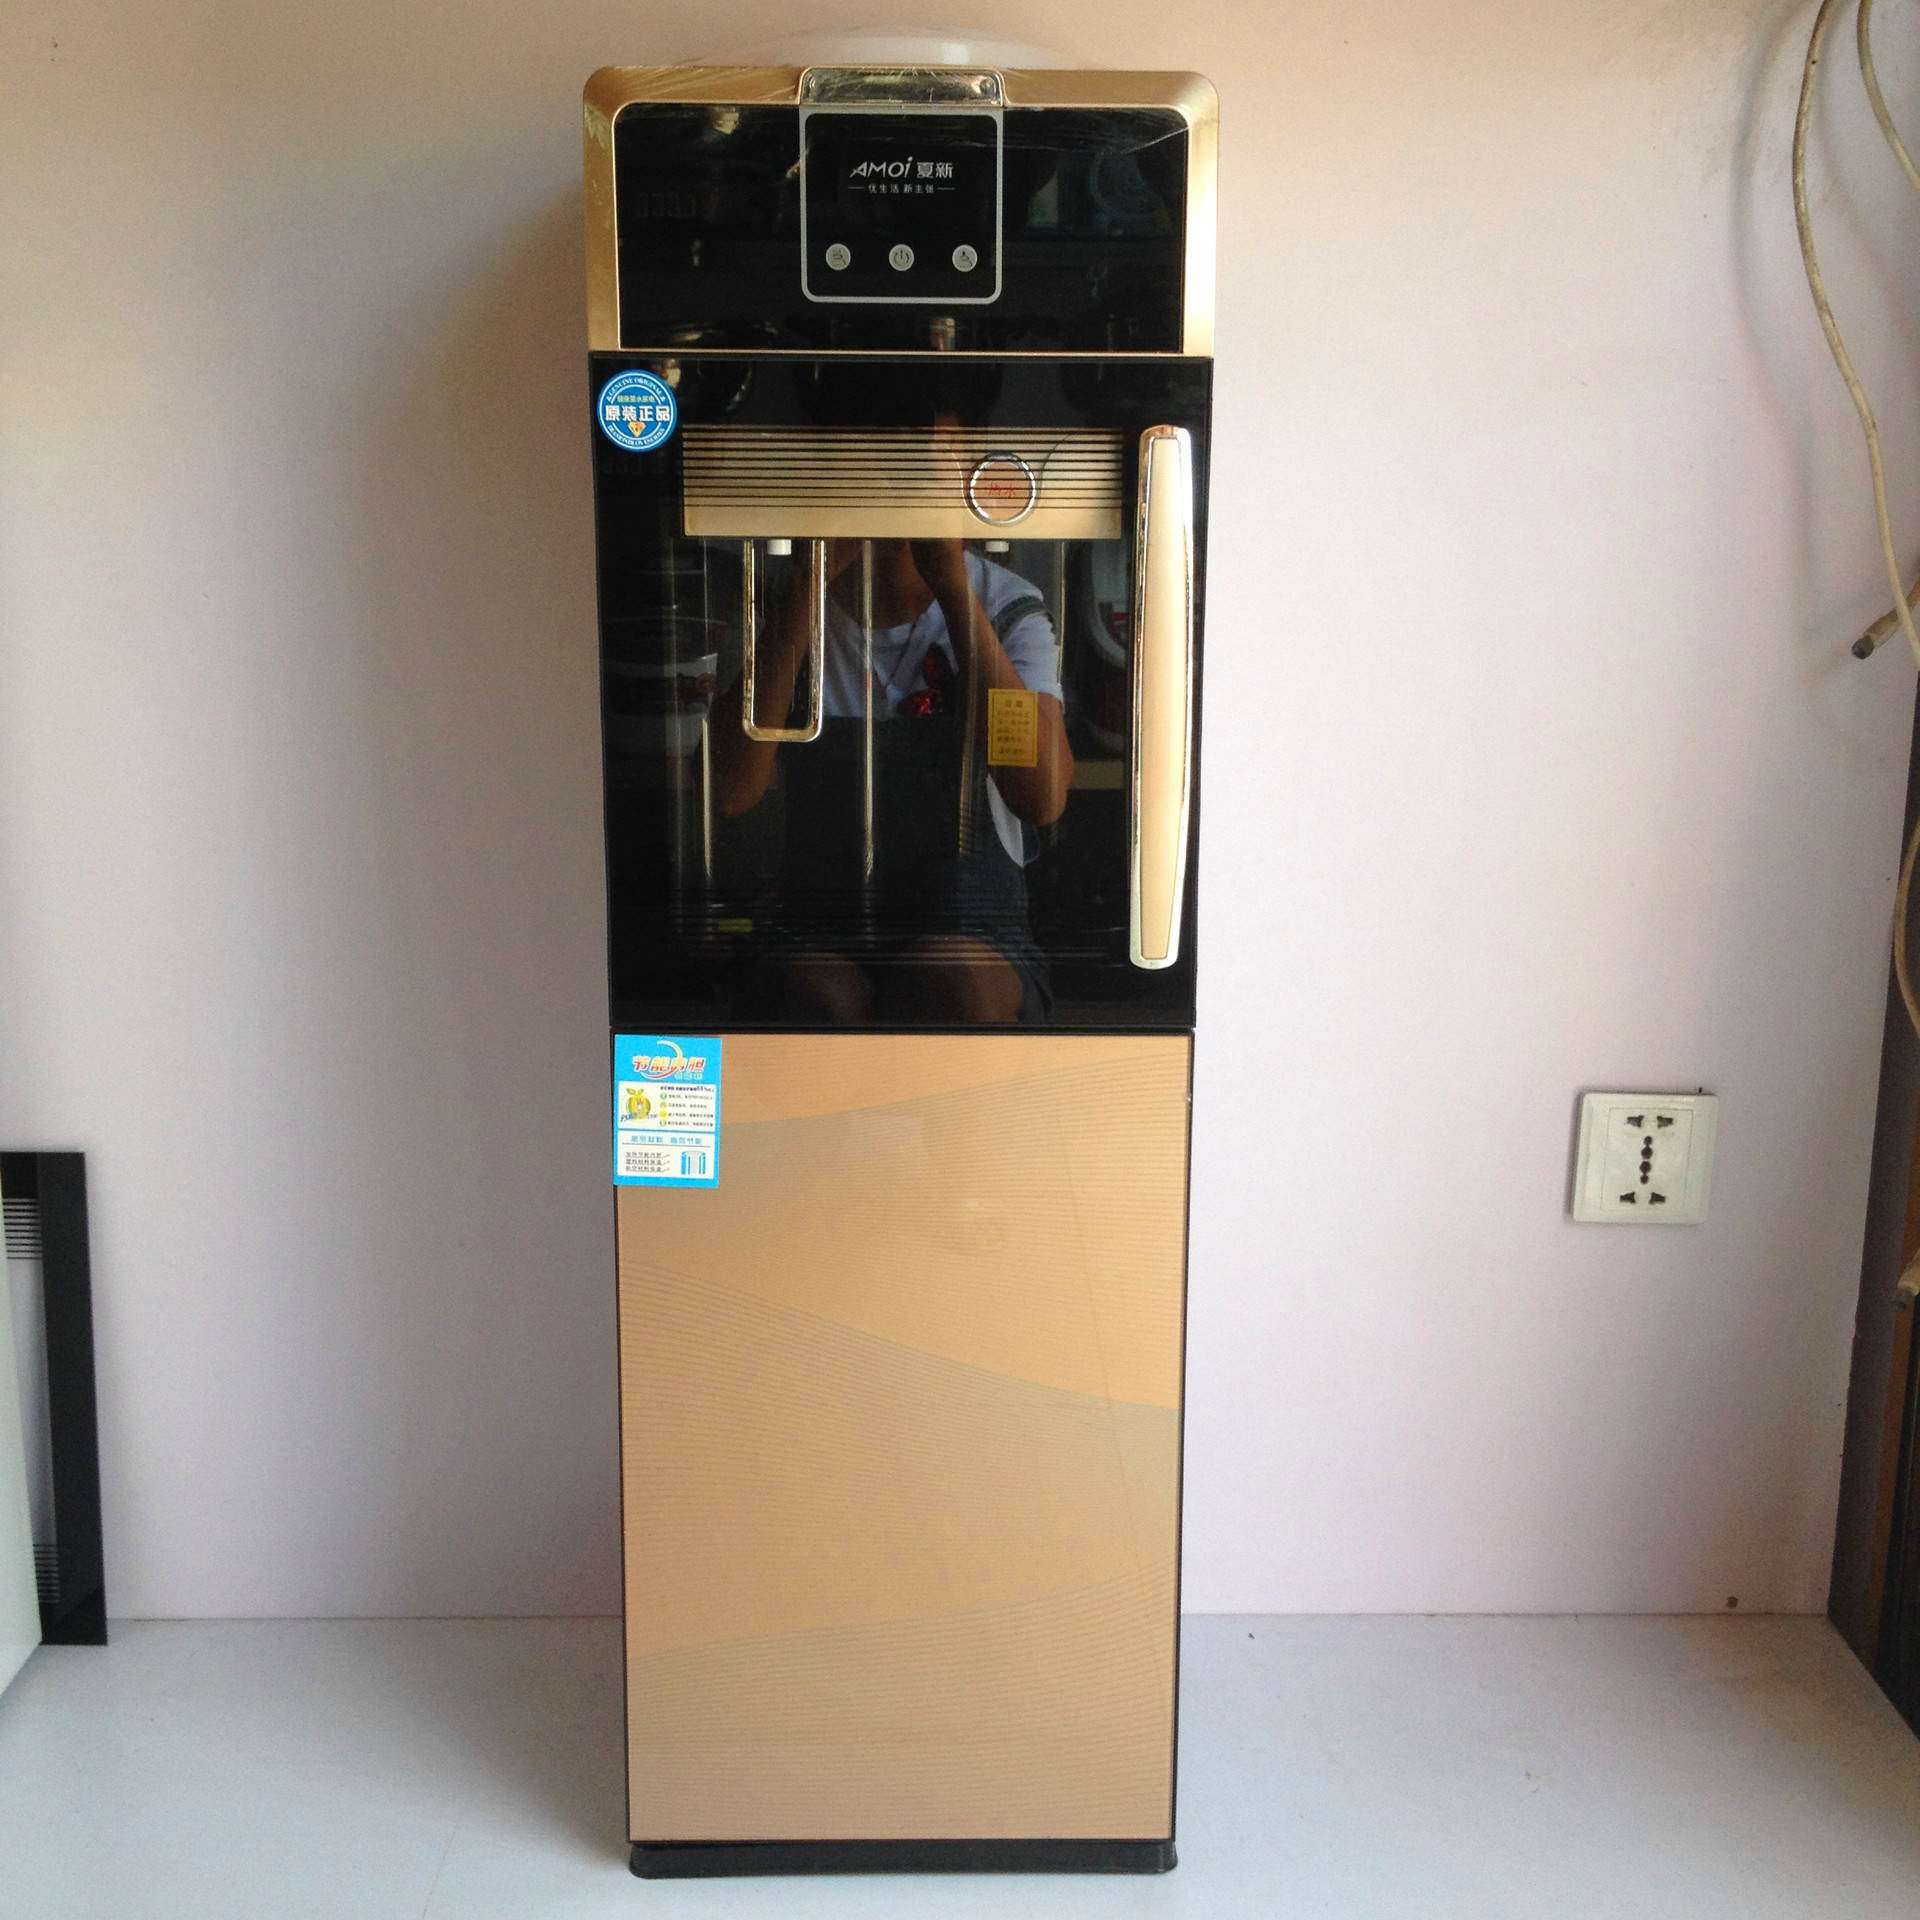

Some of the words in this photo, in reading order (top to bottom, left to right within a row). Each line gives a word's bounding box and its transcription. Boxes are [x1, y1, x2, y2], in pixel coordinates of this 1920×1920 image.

[917, 161, 953, 179] 夏新
[605, 404, 671, 422] 原装正品
[632, 1054, 707, 1073] 节能内胆
